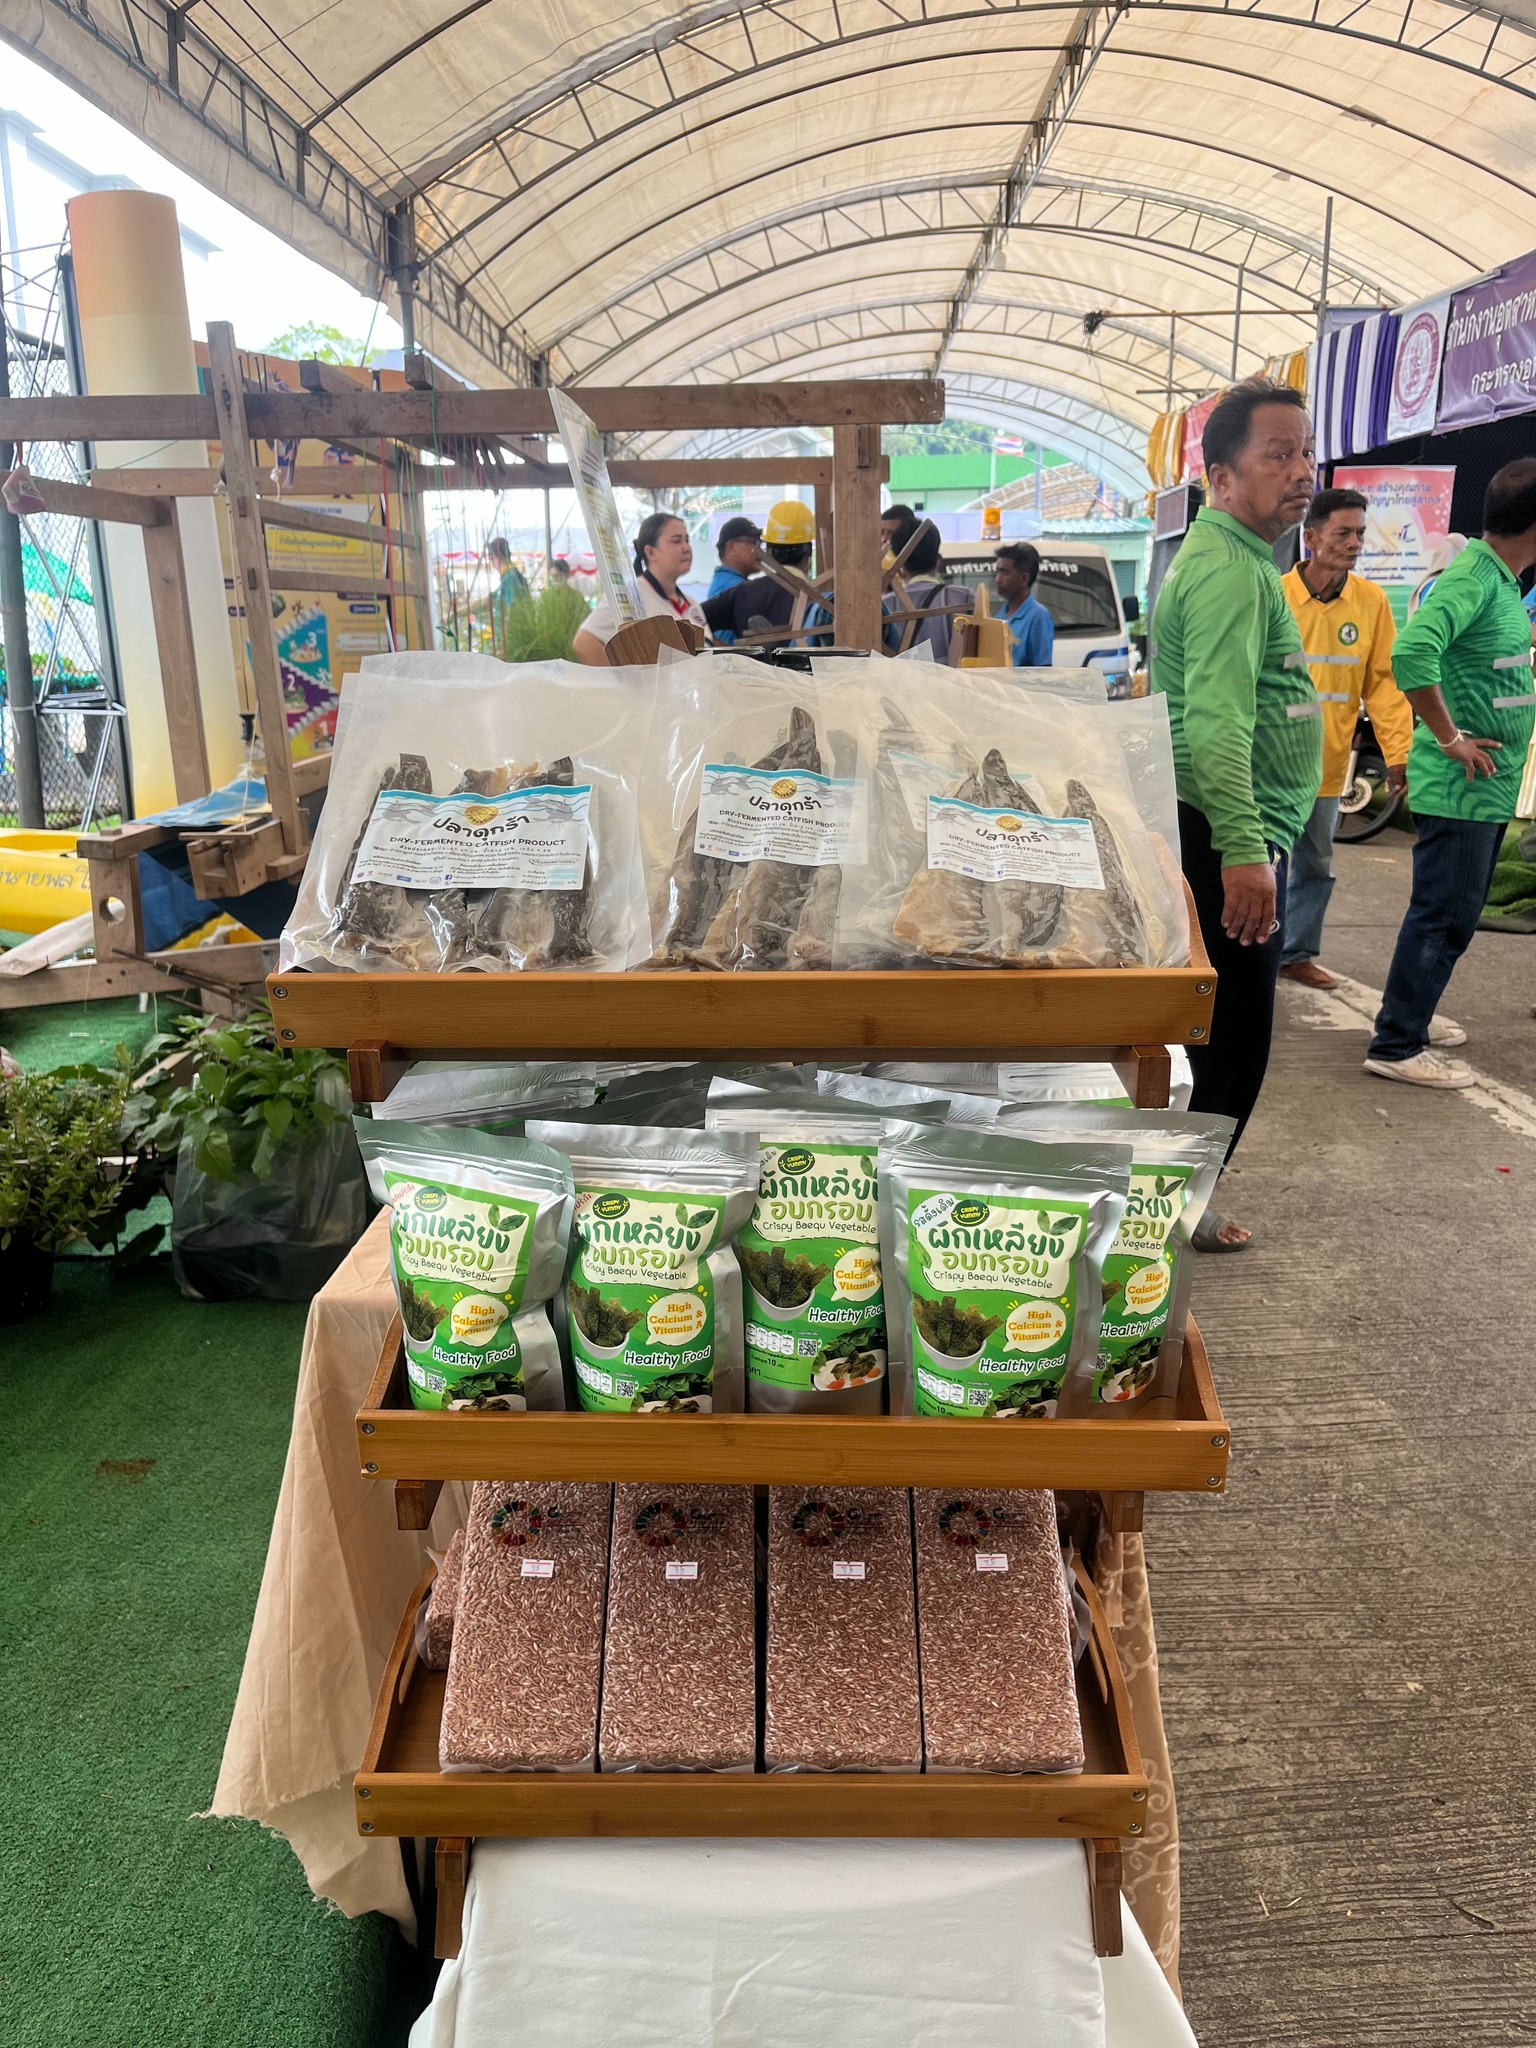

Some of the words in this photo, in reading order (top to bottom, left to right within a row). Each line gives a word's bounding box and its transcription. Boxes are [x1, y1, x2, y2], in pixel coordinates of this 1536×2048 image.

[1446, 289, 1536, 351] สำนักงานอุตสาห
[307, 631, 317, 648] 3
[287, 674, 296, 692] 2
[749, 796, 821, 815] ปลาดุกร้า
[719, 810, 781, 821] DRY-FERMENTED
[783, 815, 814, 825] CATFISH
[433, 815, 530, 840] ปลาดุกร้า
[976, 828, 1049, 845] ปลาดุกร้า
[390, 836, 473, 847] DRY-FERMENTED
[476, 838, 516, 848] CATFISH
[518, 838, 566, 847] PRODUCT
[949, 834, 1010, 849] DRY-FERMENTED
[1012, 844, 1044, 854] CATFISH
[1045, 850, 1081, 858] PRODUCT
[786, 1160, 807, 1168] YUMMY
[770, 1200, 872, 1222] อบกรอบ
[913, 1198, 954, 1227] รสดั้งเดิม
[1126, 1188, 1172, 1219] ลียง
[575, 1213, 701, 1251] ผักเหลียง
[763, 1221, 792, 1232] Crispy
[796, 1220, 825, 1231] Baequ
[829, 1221, 876, 1233] Vegetable
[1119, 1219, 1165, 1240] รอบ
[929, 1221, 1064, 1258] ผักเหลียง
[421, 1258, 448, 1272] Baequ
[451, 1264, 497, 1282] Vegetable
[585, 1259, 605, 1276] Crispy
[607, 1266, 637, 1277] Baequ
[641, 1268, 687, 1280] Vegetable
[941, 1251, 1049, 1278] อบกรอบ
[839, 1280, 875, 1290] Vitamin
[933, 1270, 964, 1282] Crispy
[967, 1271, 998, 1283] Baequ
[1002, 1274, 1053, 1289] Vegetable
[470, 1305, 495, 1316] High
[667, 1302, 692, 1313] High
[808, 1307, 862, 1325] Healthy
[1027, 1311, 1052, 1321] High
[453, 1314, 494, 1325] Calcium
[650, 1313, 693, 1324] Calcium
[696, 1310, 703, 1318] &
[1008, 1321, 1051, 1330] Calcium
[1055, 1320, 1062, 1328] &
[653, 1324, 693, 1335] Vitamin
[696, 1321, 703, 1329] A
[1012, 1332, 1050, 1341] Vitamin
[1053, 1330, 1061, 1338] A
[1100, 1321, 1149, 1338] Healthy
[433, 1346, 482, 1368] Healthy
[486, 1344, 516, 1363] Food
[624, 1350, 679, 1369] Healthy
[682, 1345, 711, 1364] Food
[768, 1358, 776, 1367] 10
[979, 1358, 1035, 1376] Healthy
[1037, 1354, 1066, 1371] Food
[937, 1405, 946, 1414] 10
